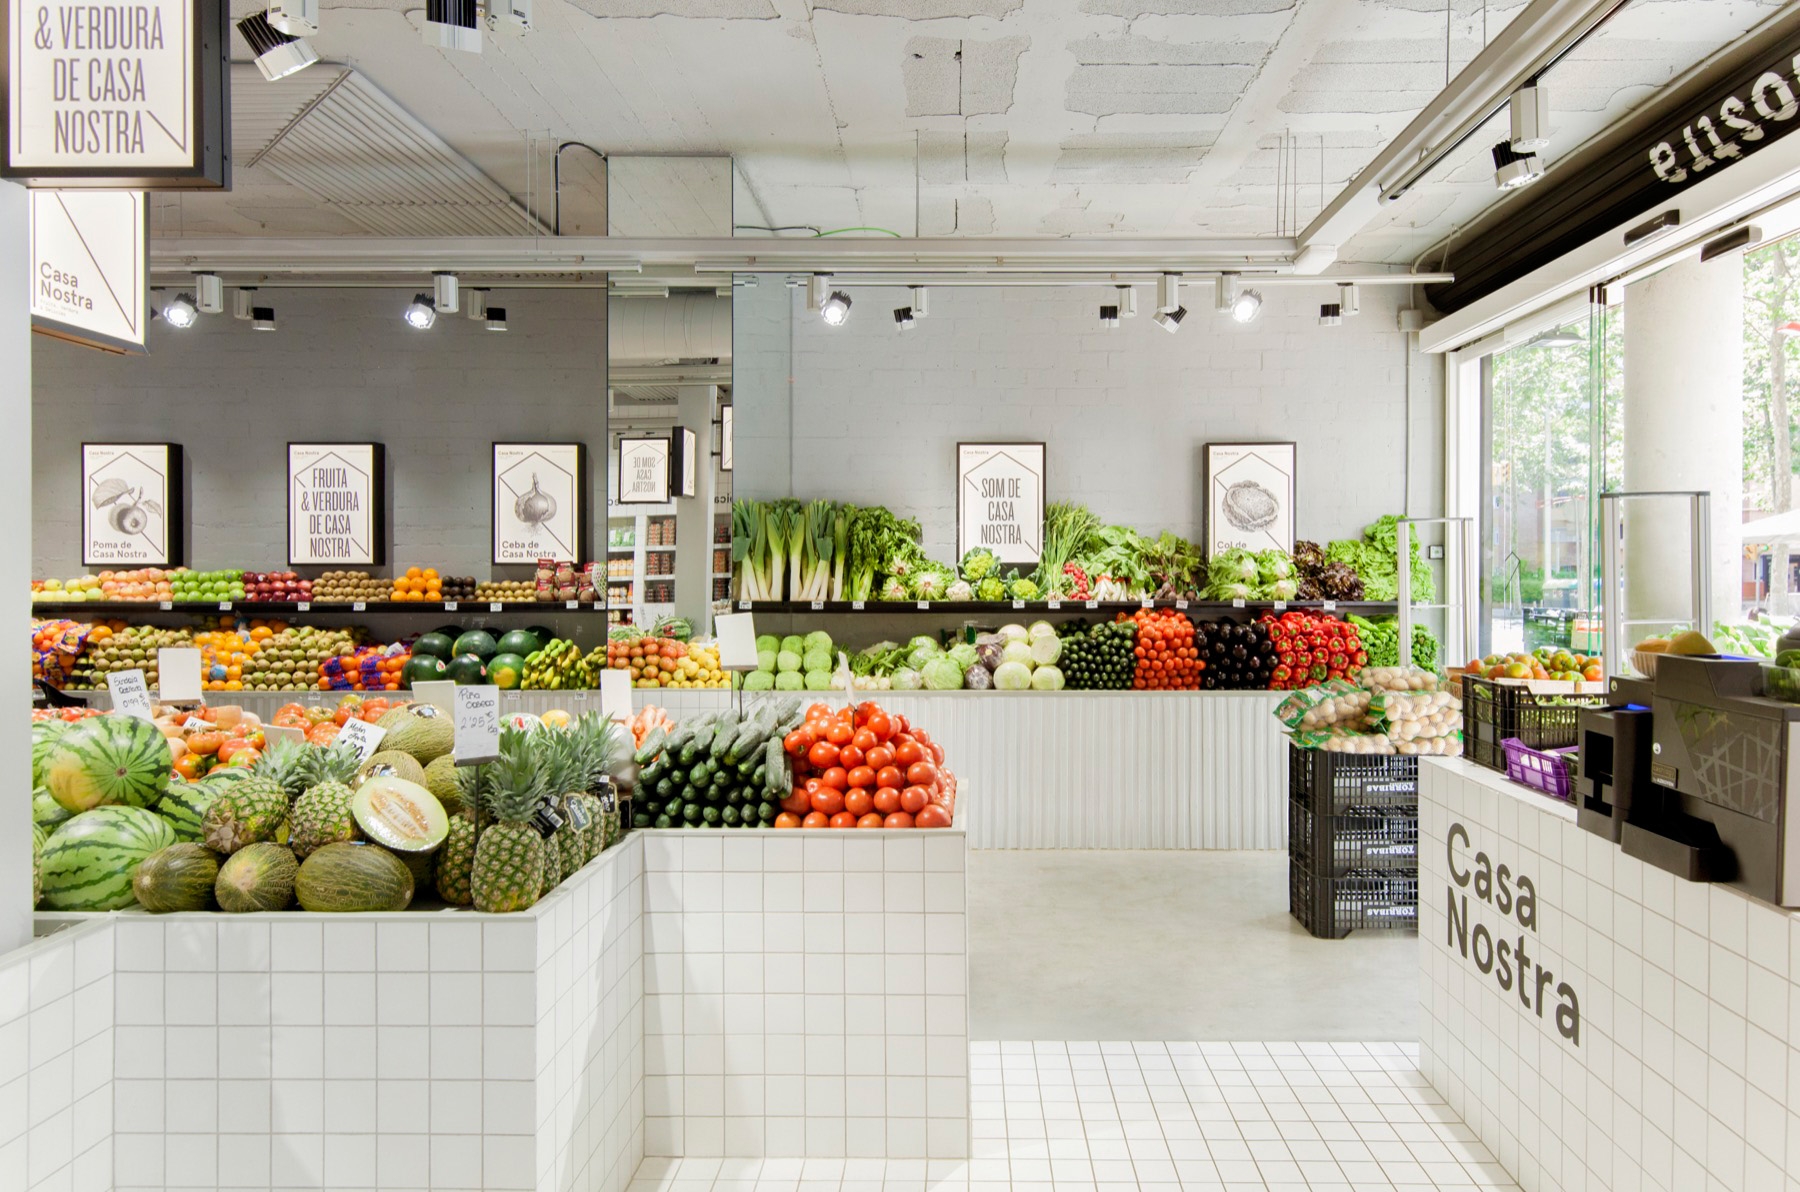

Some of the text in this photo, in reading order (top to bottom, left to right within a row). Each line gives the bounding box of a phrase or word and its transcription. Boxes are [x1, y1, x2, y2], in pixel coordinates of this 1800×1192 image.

[34, 6, 164, 50] & VERDURA
[53, 58, 146, 102] DE CASA
[1649, 53, 1800, 183] ostra
[54, 110, 145, 154] NOSTRA
[40, 261, 79, 289] Casa
[40, 279, 94, 311] Nostra
[313, 468, 348, 488] FRUITA
[981, 478, 1021, 498] SOM DE
[301, 491, 360, 512] & VERDURA
[988, 501, 1015, 521] CASA
[309, 514, 351, 534] DE CASA
[981, 524, 1022, 544] NOSTRA
[93, 541, 132, 549] Poma de
[93, 550, 148, 558] Casa Nostra
[310, 537, 351, 558] NOSTRA
[502, 540, 539, 549] Ceba de
[502, 550, 557, 558] Casa Nostra
[1217, 541, 1247, 549] Col de
[1367, 782, 1414, 792] TORRIBAS
[1367, 845, 1414, 855] TORRIBAS
[1447, 822, 1537, 933] Casa
[1367, 906, 1414, 916] TORRIBAS
[1447, 885, 1579, 1048] Nostra
